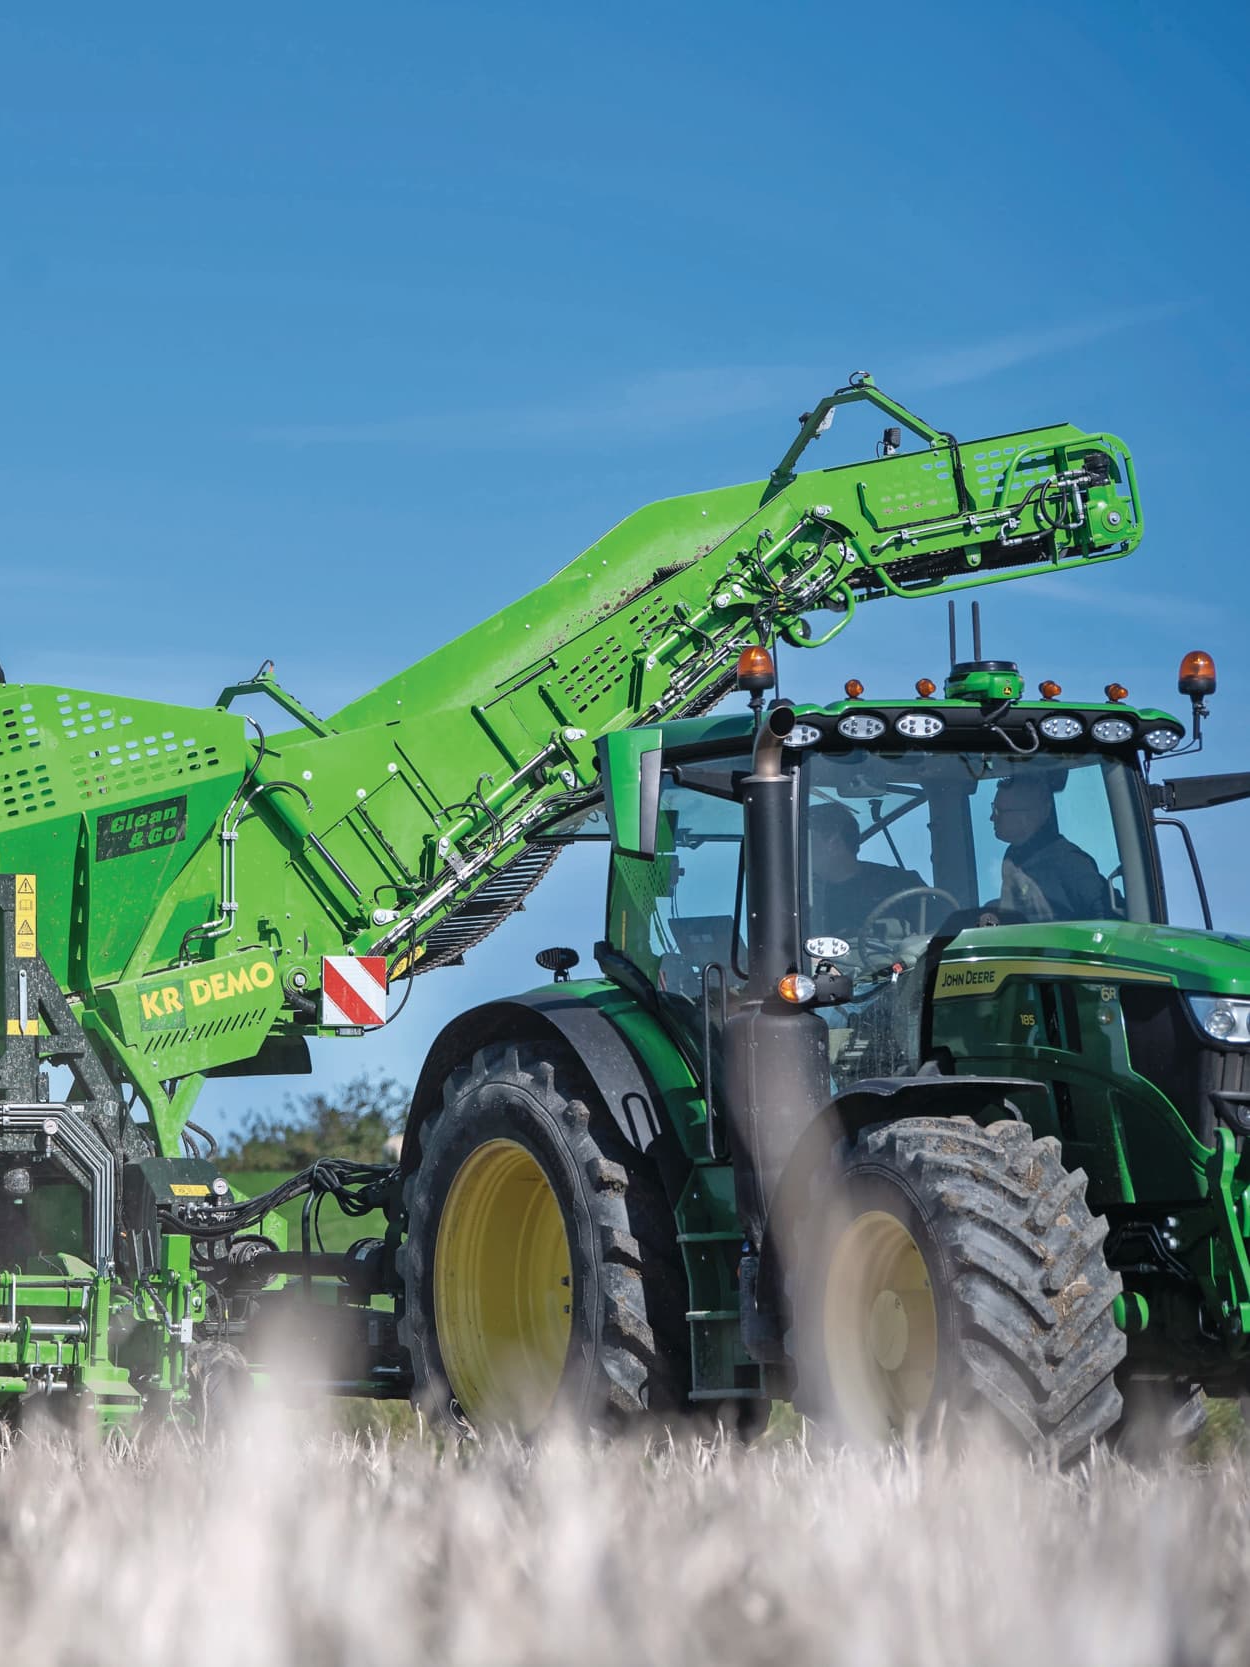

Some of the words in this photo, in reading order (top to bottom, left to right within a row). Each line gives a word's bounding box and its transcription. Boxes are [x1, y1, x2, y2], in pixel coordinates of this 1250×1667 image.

[110, 806, 178, 833] Clean
[128, 831, 144, 849] &
[148, 826, 177, 845] Go
[941, 972, 965, 988] JOHN
[965, 970, 995, 985] DEERE
[140, 987, 184, 1020] KR
[189, 961, 275, 1006] DEMO
[1101, 987, 1117, 1002] 6R
[1020, 1014, 1036, 1026] 185
